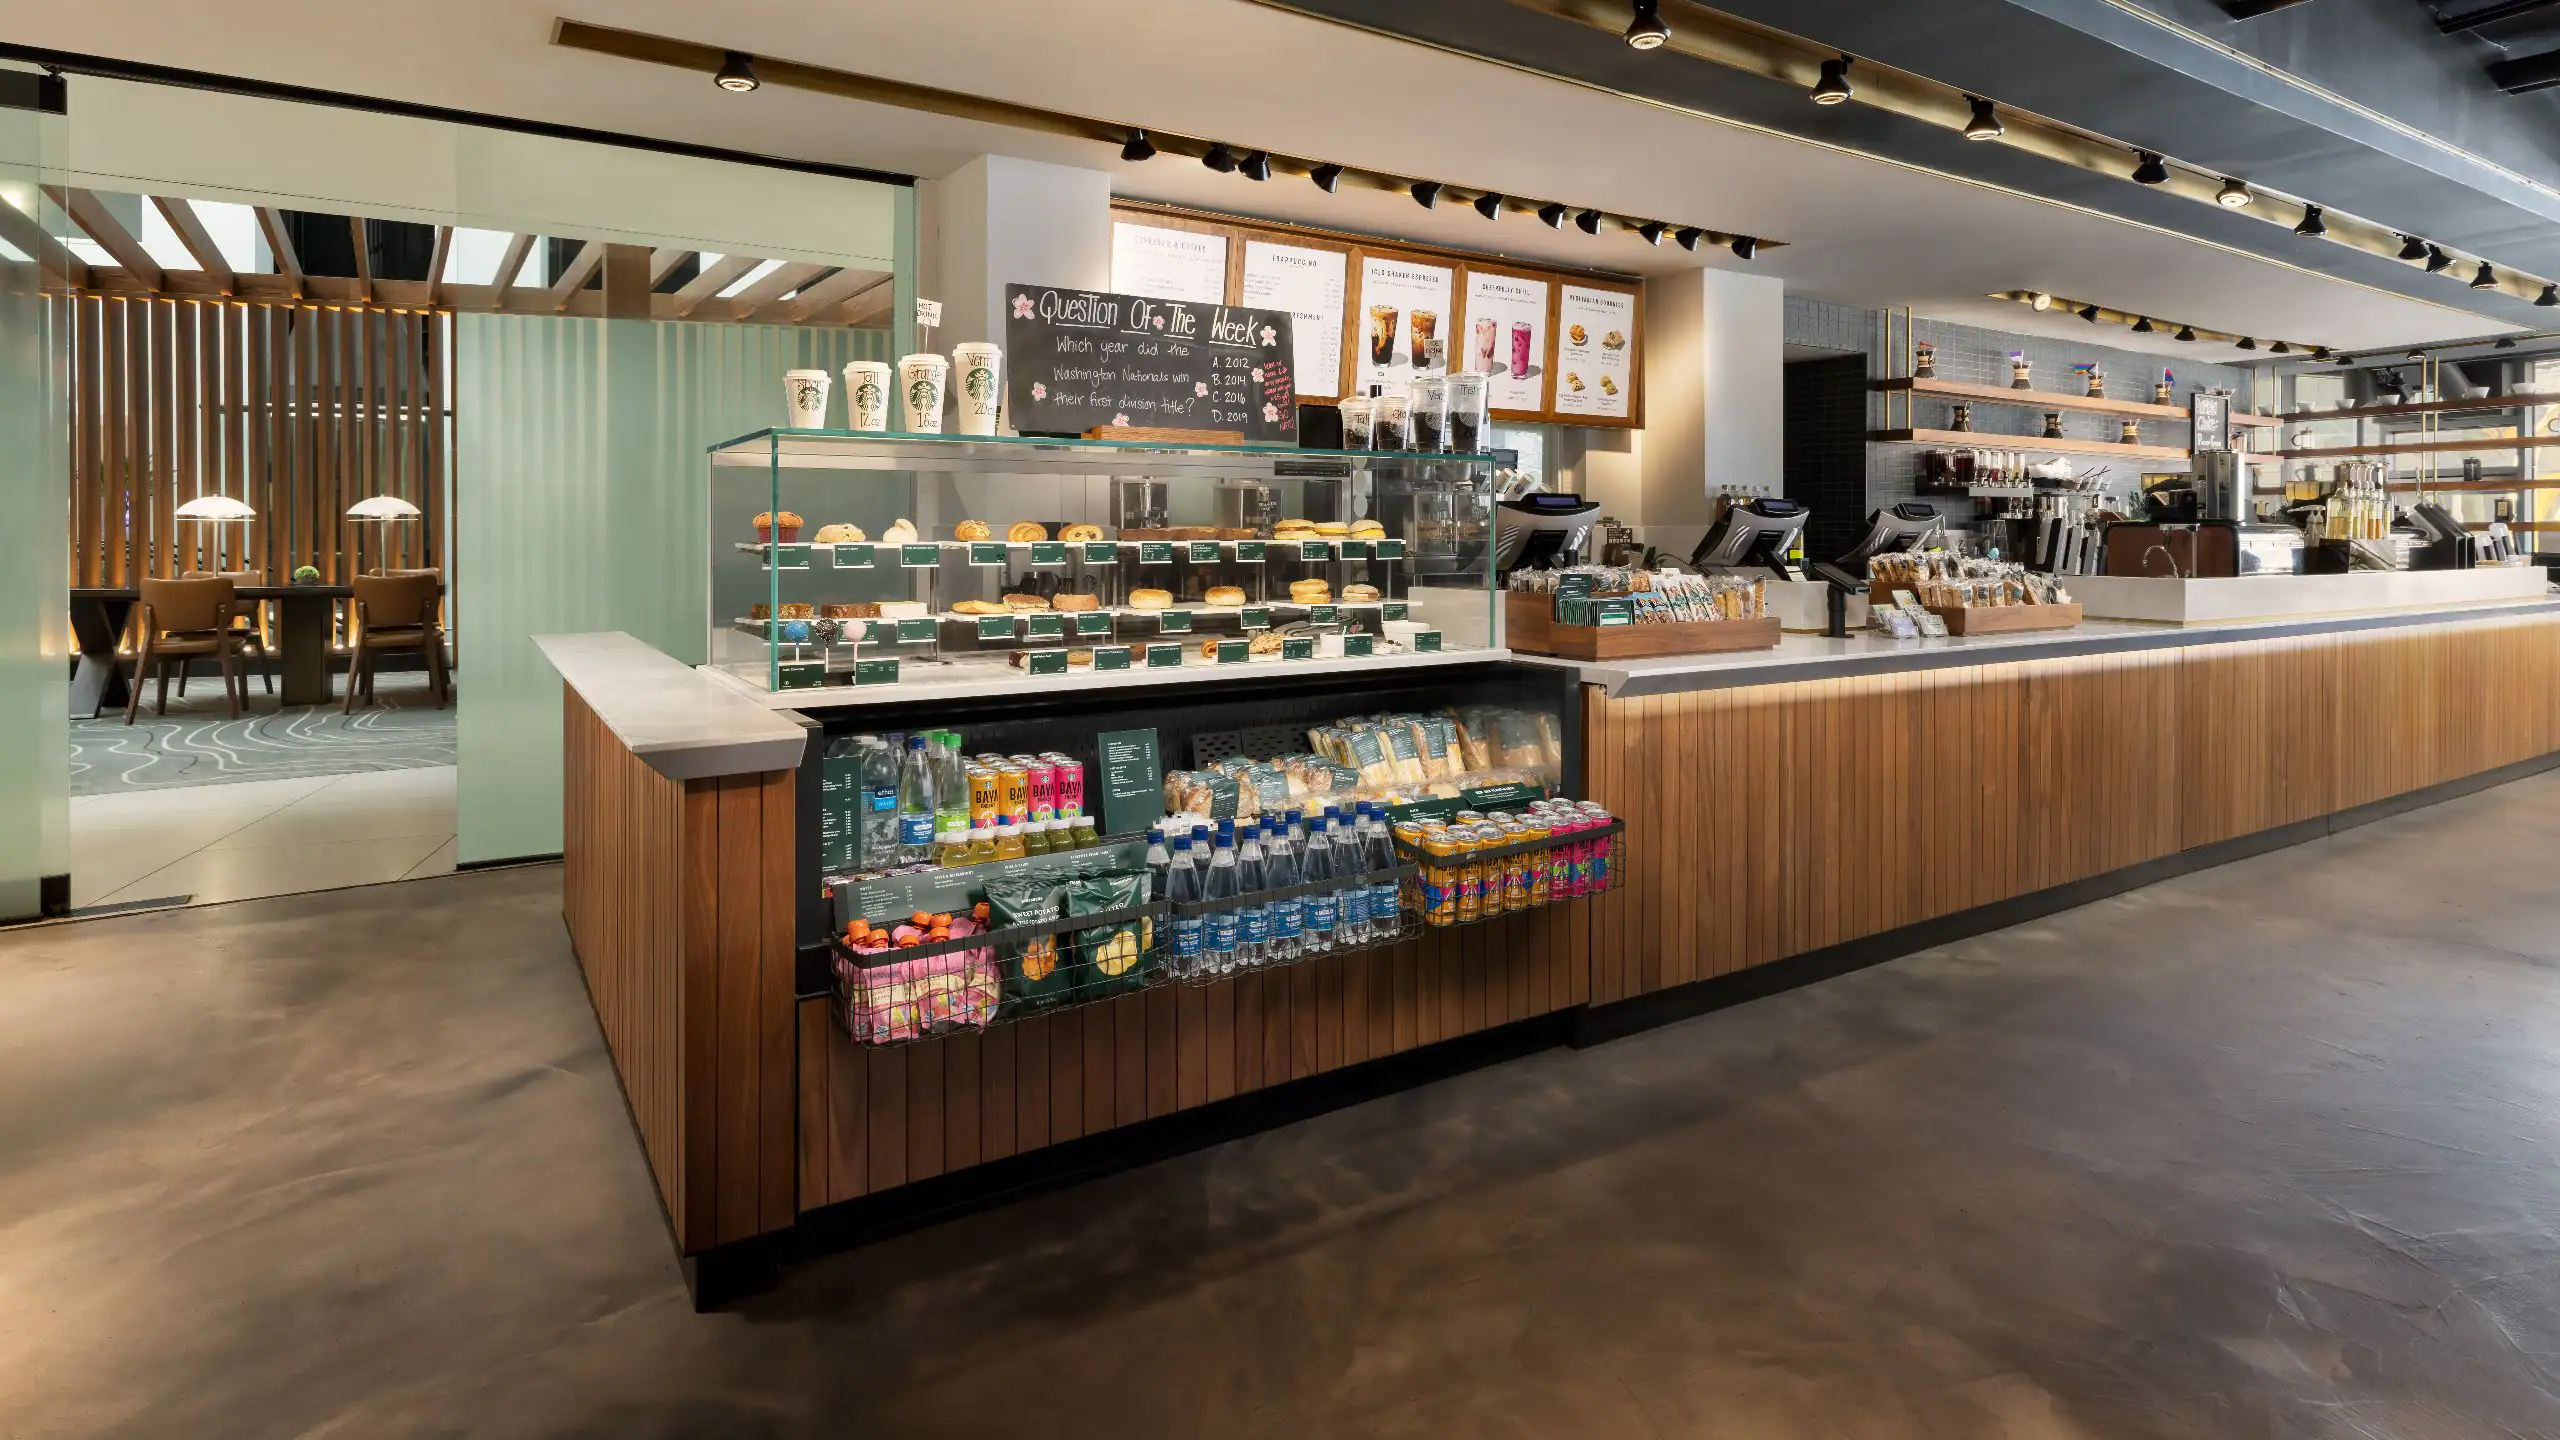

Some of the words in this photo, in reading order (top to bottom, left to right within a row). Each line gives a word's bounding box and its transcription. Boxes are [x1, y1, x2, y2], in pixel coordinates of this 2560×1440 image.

[1039, 290, 1118, 326] Question
[1130, 299, 1157, 331] Of
[1165, 303, 1196, 334] The
[1210, 306, 1259, 345] Week
[1056, 336, 1093, 354] Which
[1099, 342, 1129, 363] year
[1137, 341, 1159, 356] did
[1167, 342, 1190, 357] the
[1212, 356, 1222, 369] A.
[1225, 357, 1250, 369] 2012
[1053, 364, 1117, 388] Washington
[1122, 364, 1169, 383] Nationals
[1172, 371, 1191, 384] win
[1211, 373, 1223, 386] B.
[1224, 374, 1246, 387] 2014
[1053, 391, 1086, 407] their
[1089, 391, 1114, 408] first
[1118, 393, 1158, 412] division
[1212, 390, 1222, 403] C.
[1224, 391, 1246, 405] 2016
[1211, 409, 1224, 423] D.
[1227, 412, 1248, 424] 2019
[1033, 784, 1056, 798] BAYA
[1060, 781, 1082, 795] BAYA
[975, 789, 999, 804] BAYA
[1012, 910, 1033, 920] SWEET
[1034, 905, 1060, 916] POTATO
